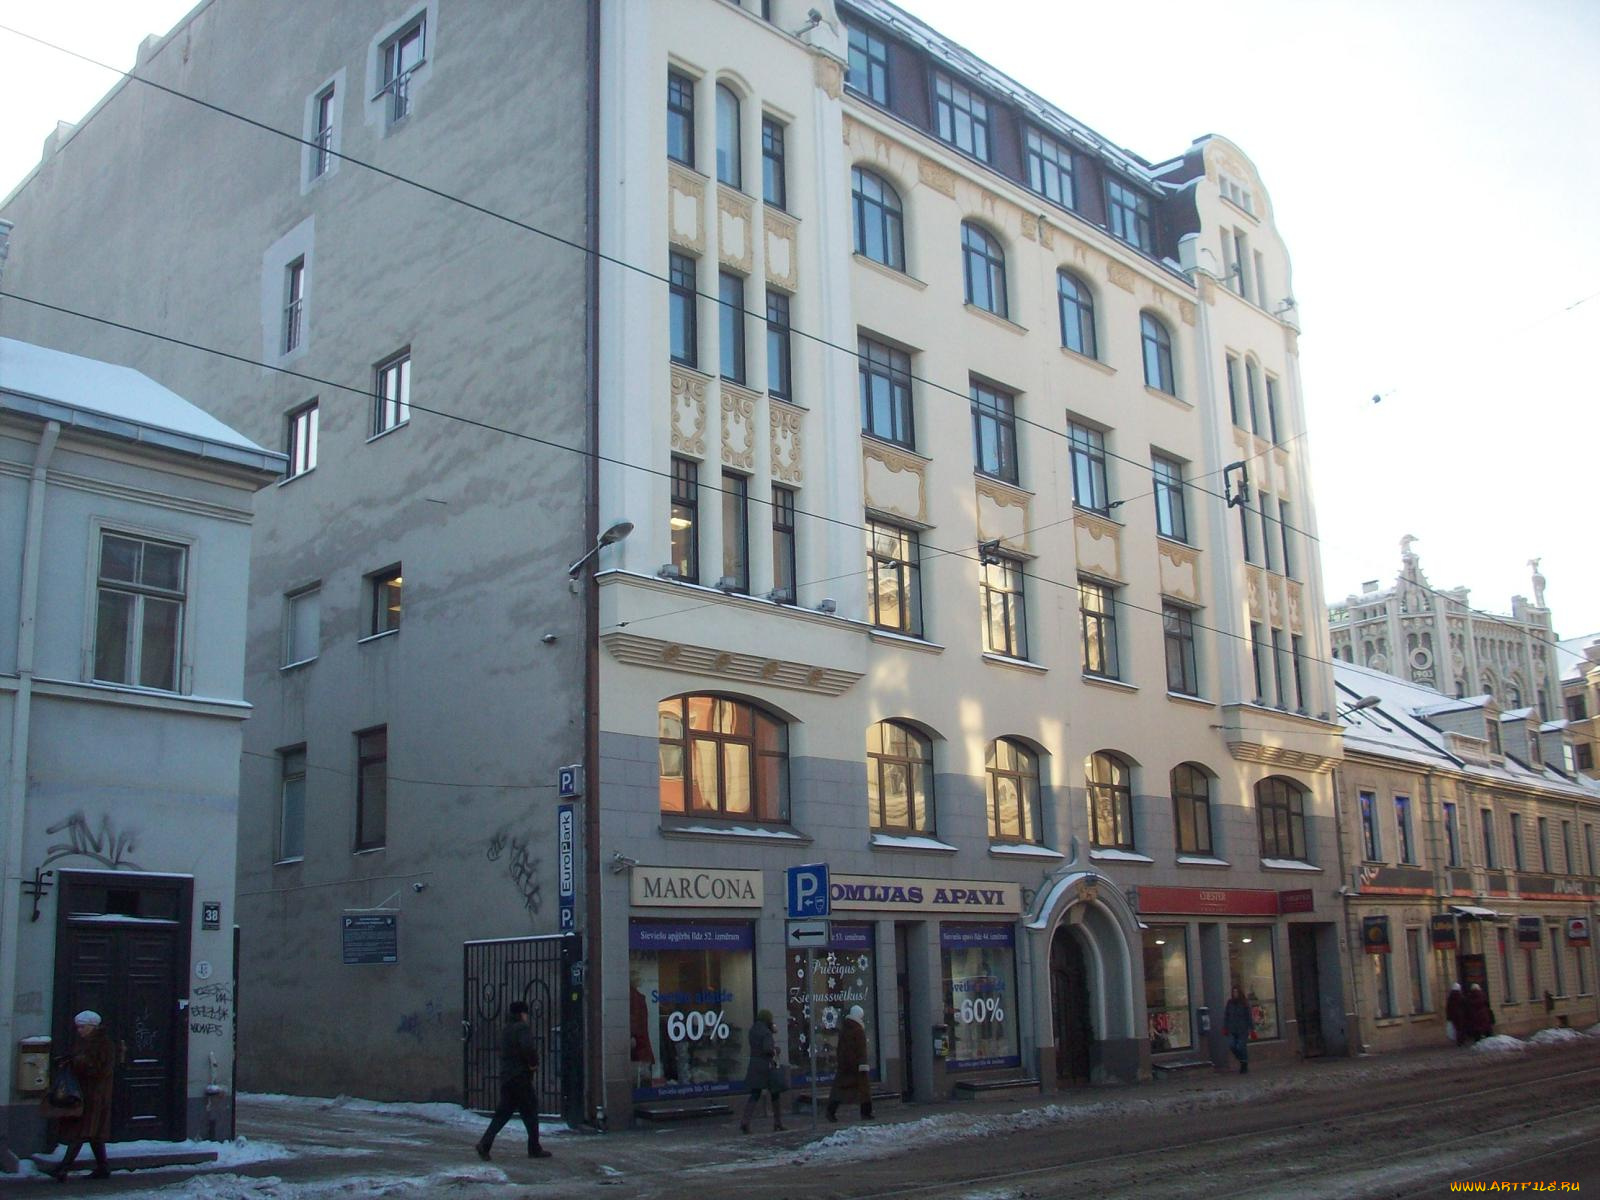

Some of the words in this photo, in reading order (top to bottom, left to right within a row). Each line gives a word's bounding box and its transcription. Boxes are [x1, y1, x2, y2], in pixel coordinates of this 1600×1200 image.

[561, 814, 571, 892] EuroPark
[796, 872, 818, 912] P
[830, 883, 924, 903] OMIJAS
[932, 887, 1006, 906] APAVI
[205, 909, 219, 921] 38
[960, 997, 1004, 1024] 60%
[667, 1010, 731, 1042] 60%
